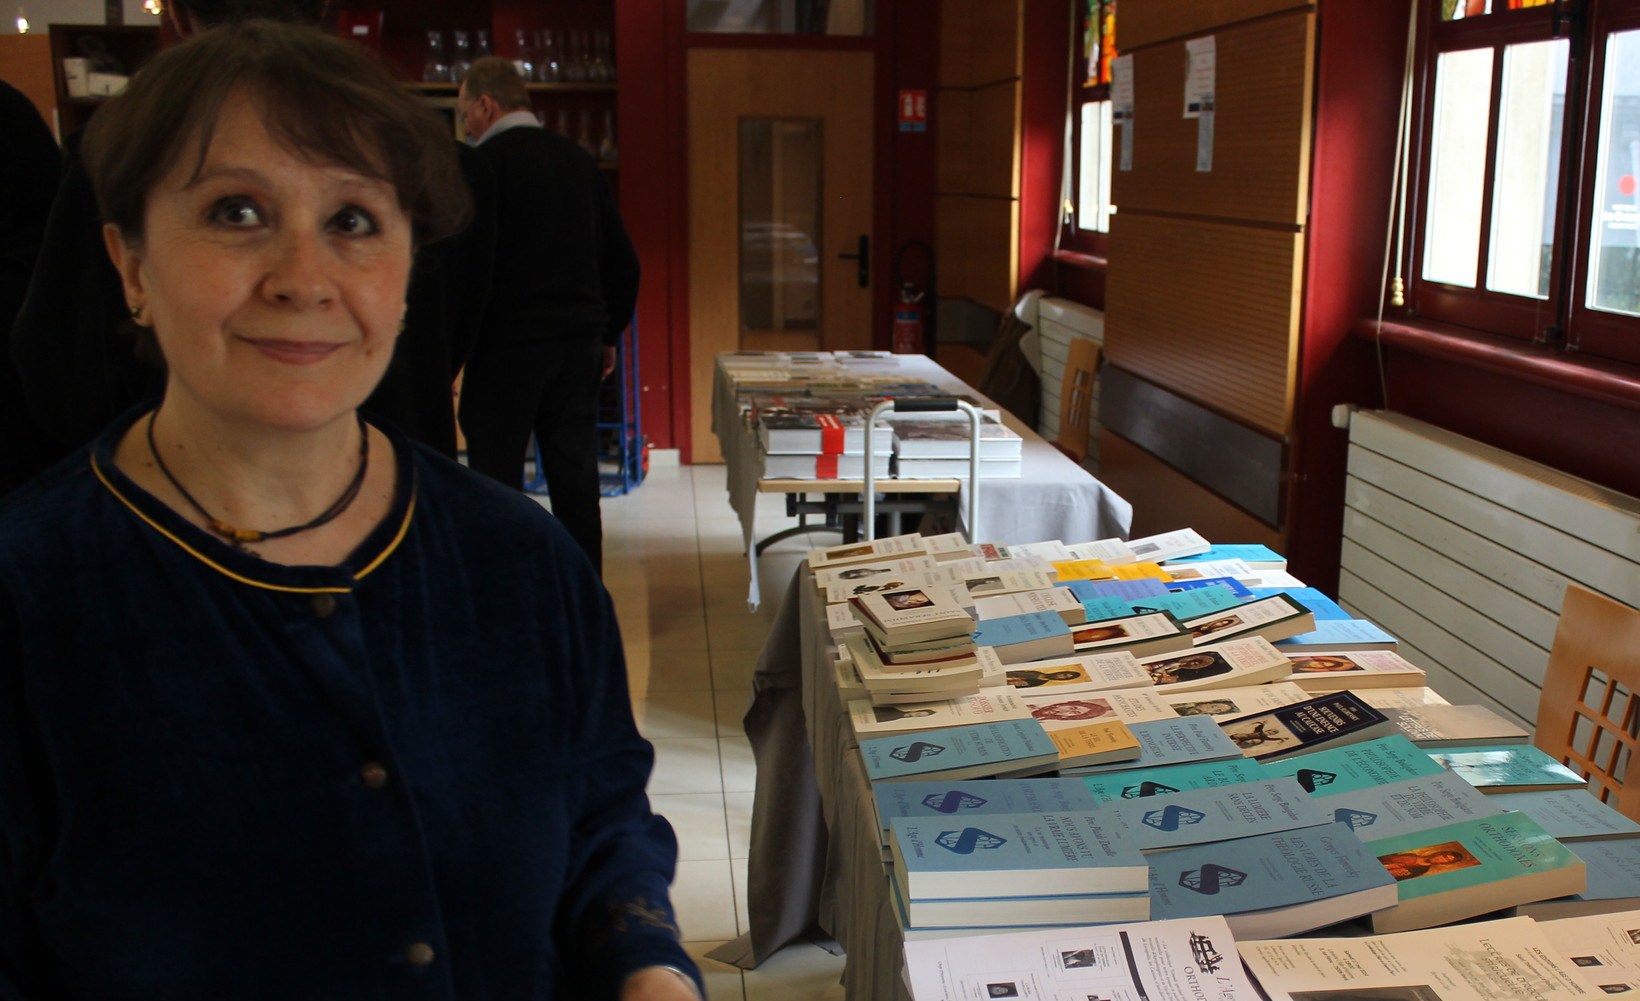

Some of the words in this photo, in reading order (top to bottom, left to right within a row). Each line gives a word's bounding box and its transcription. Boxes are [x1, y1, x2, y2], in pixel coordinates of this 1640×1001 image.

[1361, 749, 1402, 779] PHILOSOPHIE
[1047, 822, 1065, 838] VRAIE
[1061, 816, 1078, 832] NOUS
[1069, 832, 1089, 850] AVONS
[1478, 823, 1534, 868] ORTHODOXES
[1501, 826, 1545, 858] SERMONS
[1299, 848, 1323, 868] VOIES
[1298, 874, 1326, 897] RUSSE
